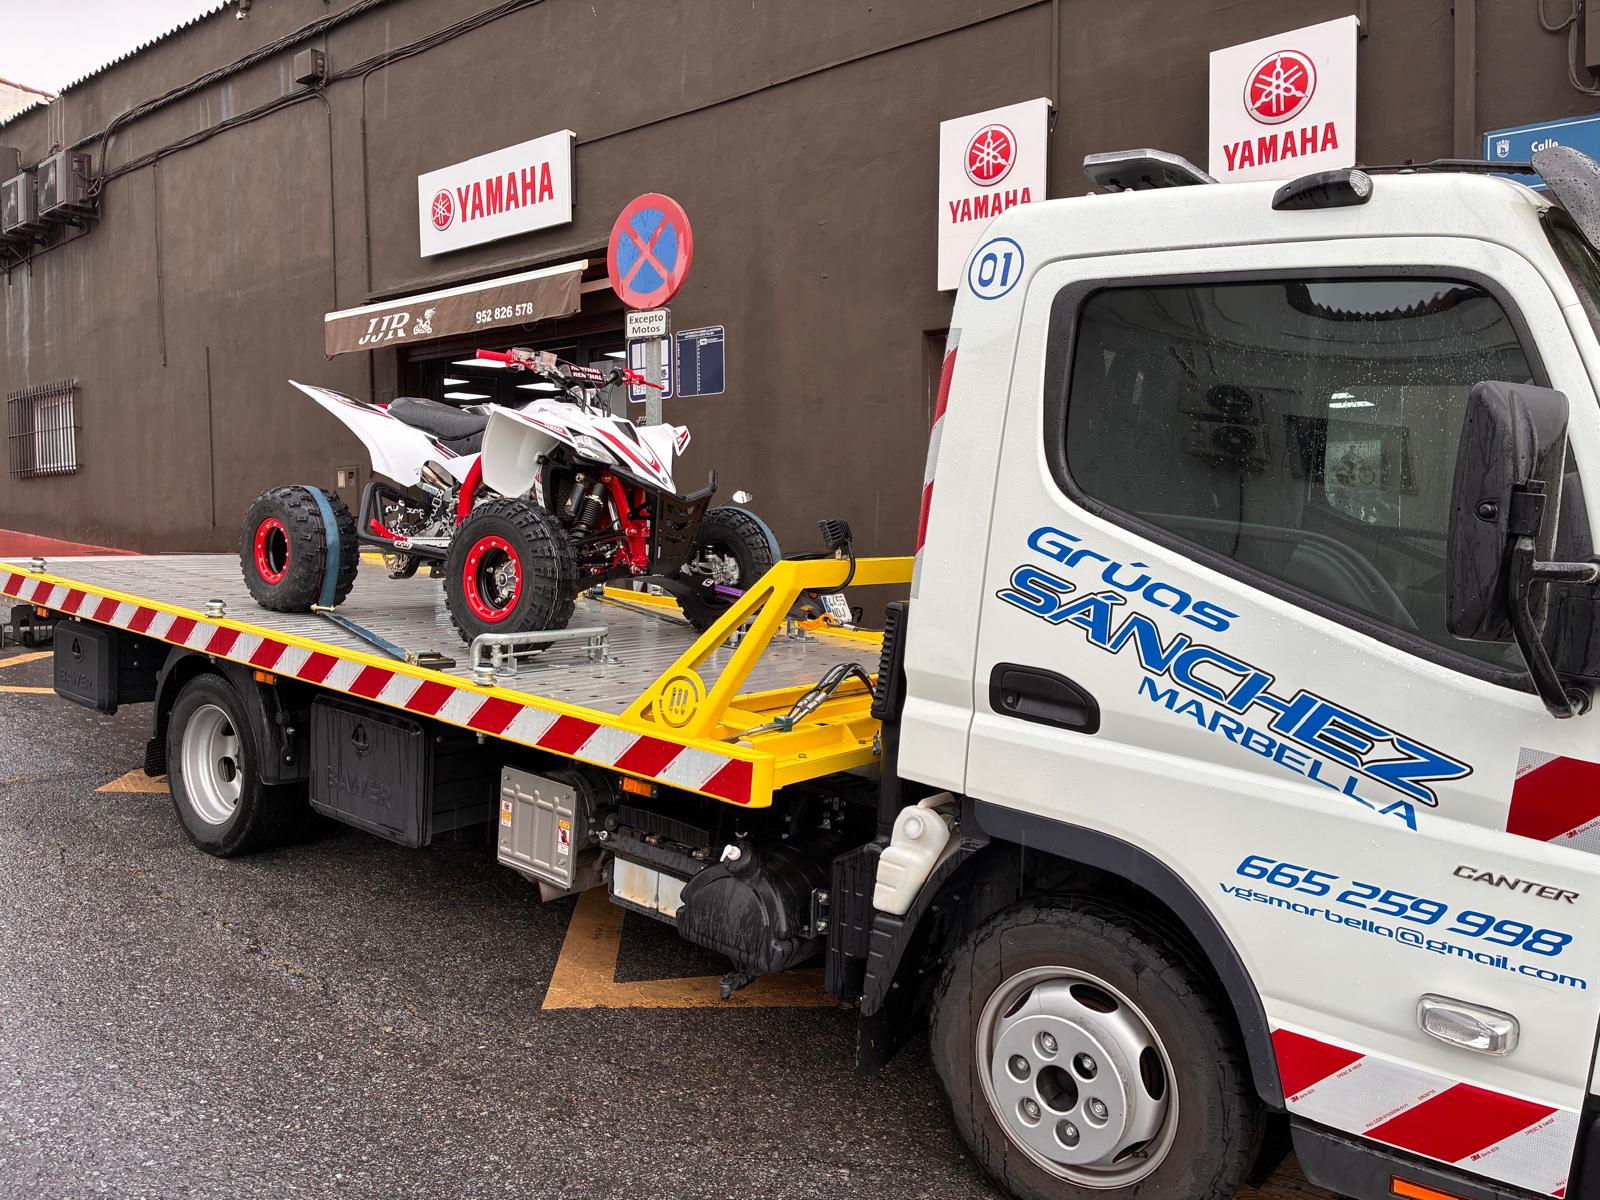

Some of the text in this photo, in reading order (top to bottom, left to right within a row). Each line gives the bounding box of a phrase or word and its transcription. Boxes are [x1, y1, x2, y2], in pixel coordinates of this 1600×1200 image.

[1223, 122, 1338, 171] YAMAHA
[457, 162, 554, 223] YAMAHA
[949, 187, 1031, 224] YAMAHA
[978, 252, 1013, 288] 01
[358, 312, 410, 345] JJR
[476, 302, 533, 324] 952 826 578
[629, 314, 664, 325] Excepto
[632, 326, 661, 335] Motos
[1027, 526, 1239, 633] Grúas
[997, 564, 1473, 807] SÁNCHEZ
[1138, 676, 1418, 831] MARBELLA
[1236, 855, 1573, 957] 665 259 998
[1453, 864, 1580, 906] CANTER
[1219, 883, 1587, 990] vgsmarbella@gmail.com
